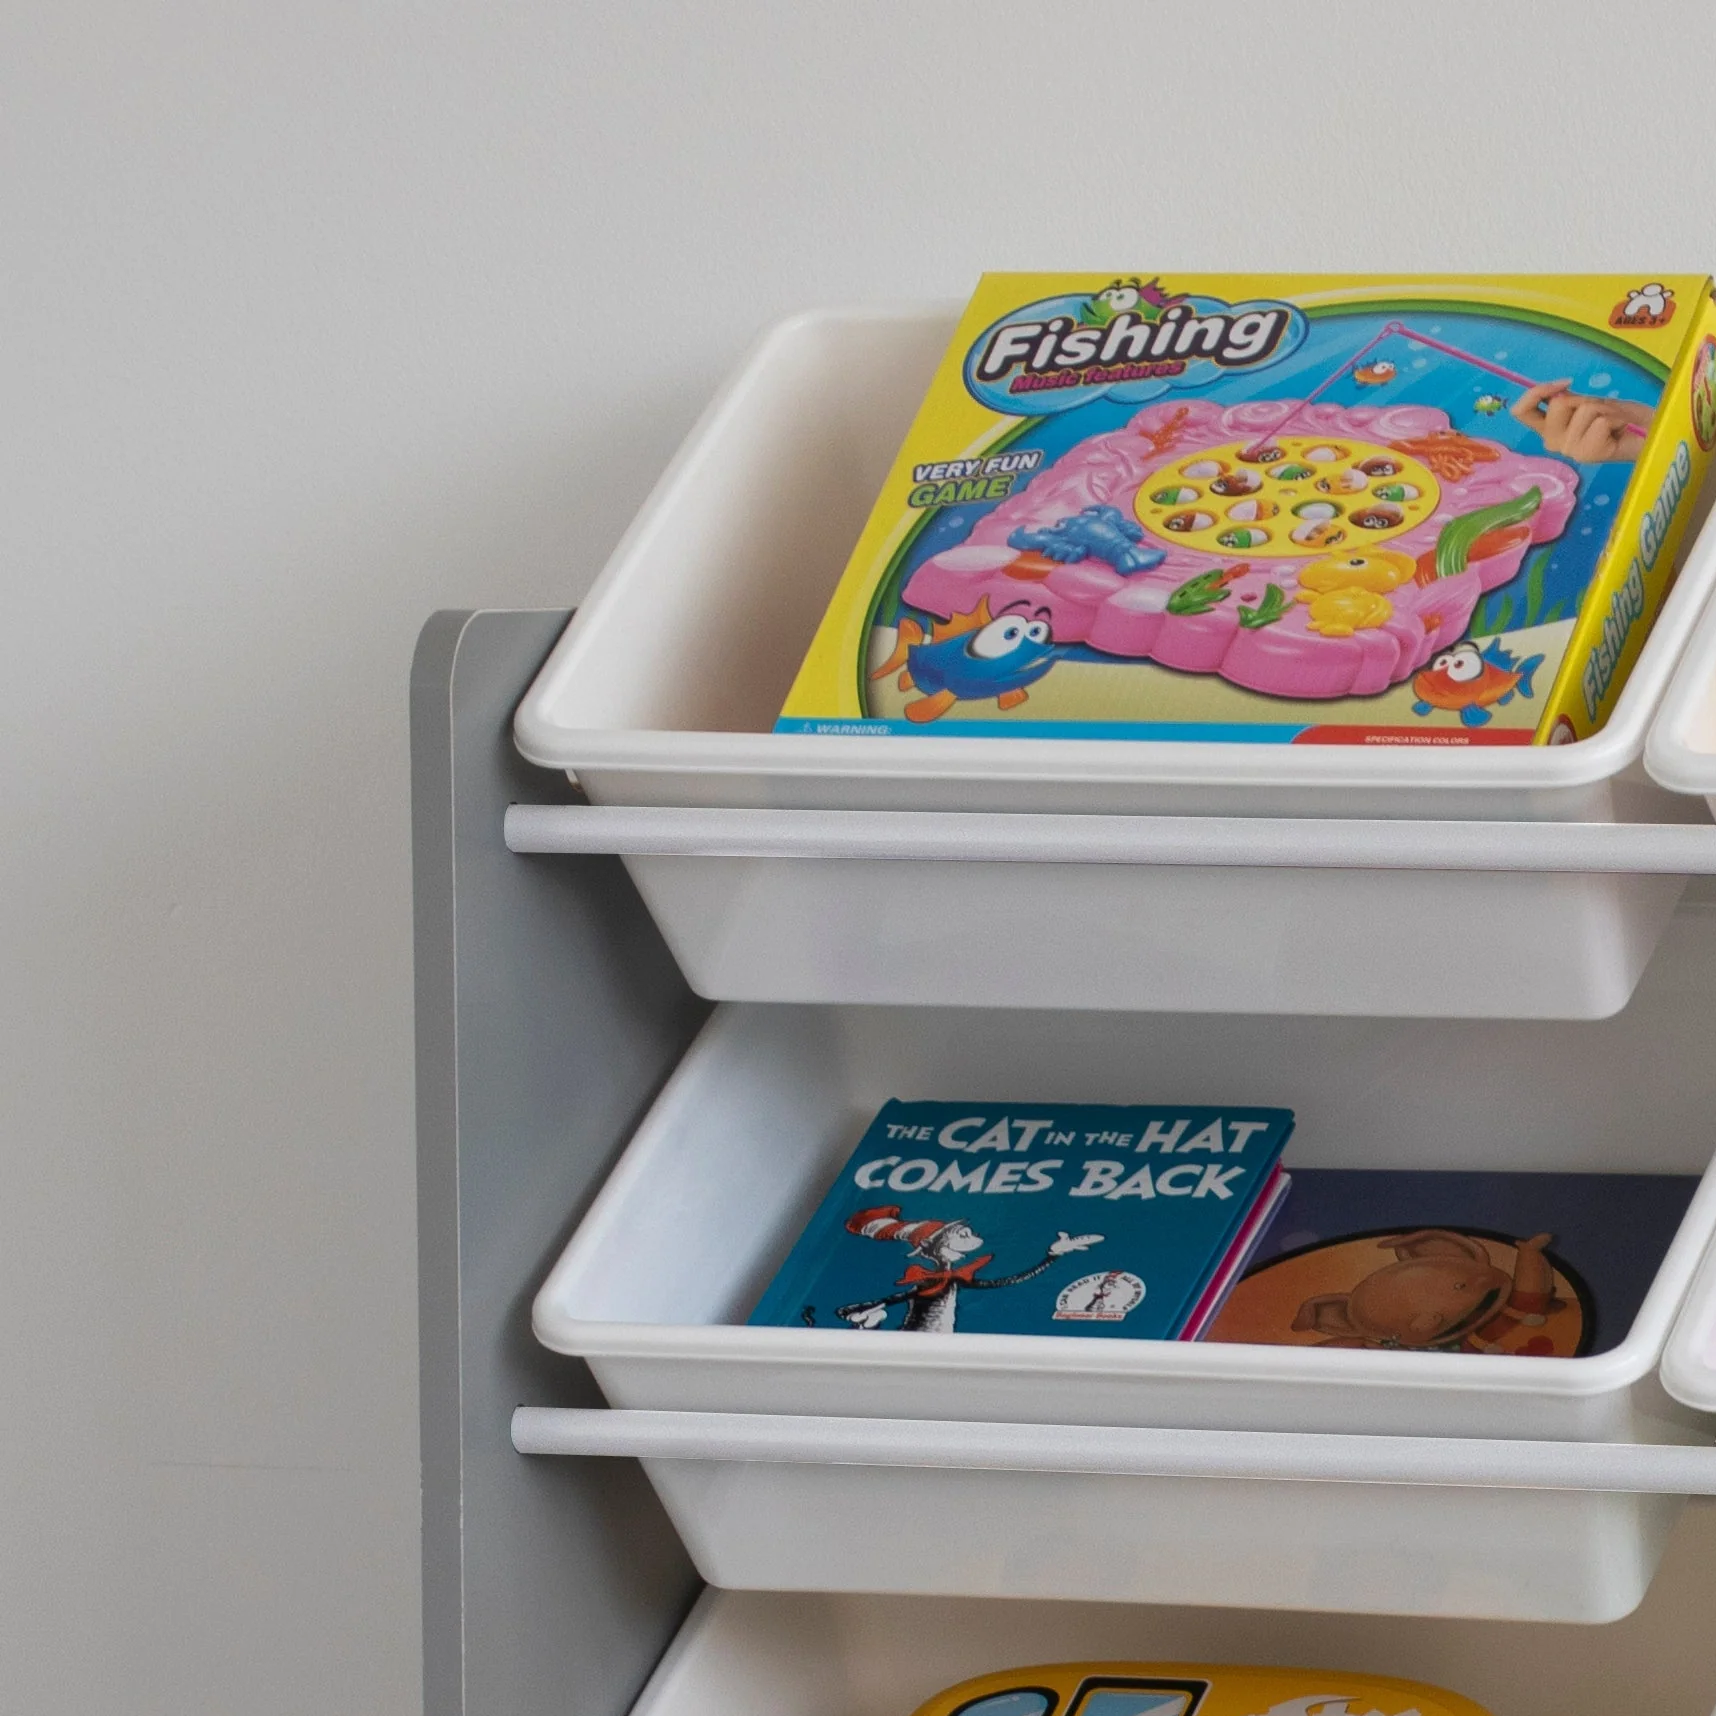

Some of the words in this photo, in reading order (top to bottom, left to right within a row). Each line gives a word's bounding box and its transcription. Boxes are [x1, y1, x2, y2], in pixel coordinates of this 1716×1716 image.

[982, 304, 1282, 376] Fishing
[1010, 369, 1081, 393] Music
[1084, 361, 1187, 384] features
[913, 459, 983, 483] VERY
[983, 451, 1042, 474] FUN
[909, 475, 1014, 507] GAME
[1582, 557, 1645, 724] Fishing
[1639, 440, 1691, 571] Game
[1432, 736, 1470, 745] COLORS
[886, 1124, 934, 1141] THE
[938, 1116, 1054, 1154] CAT
[1044, 1131, 1076, 1146] IN
[1085, 1131, 1134, 1147] THE
[1134, 1117, 1270, 1154] HAT
[854, 1155, 1064, 1194] COMES
[1068, 1159, 1247, 1200] BACK
